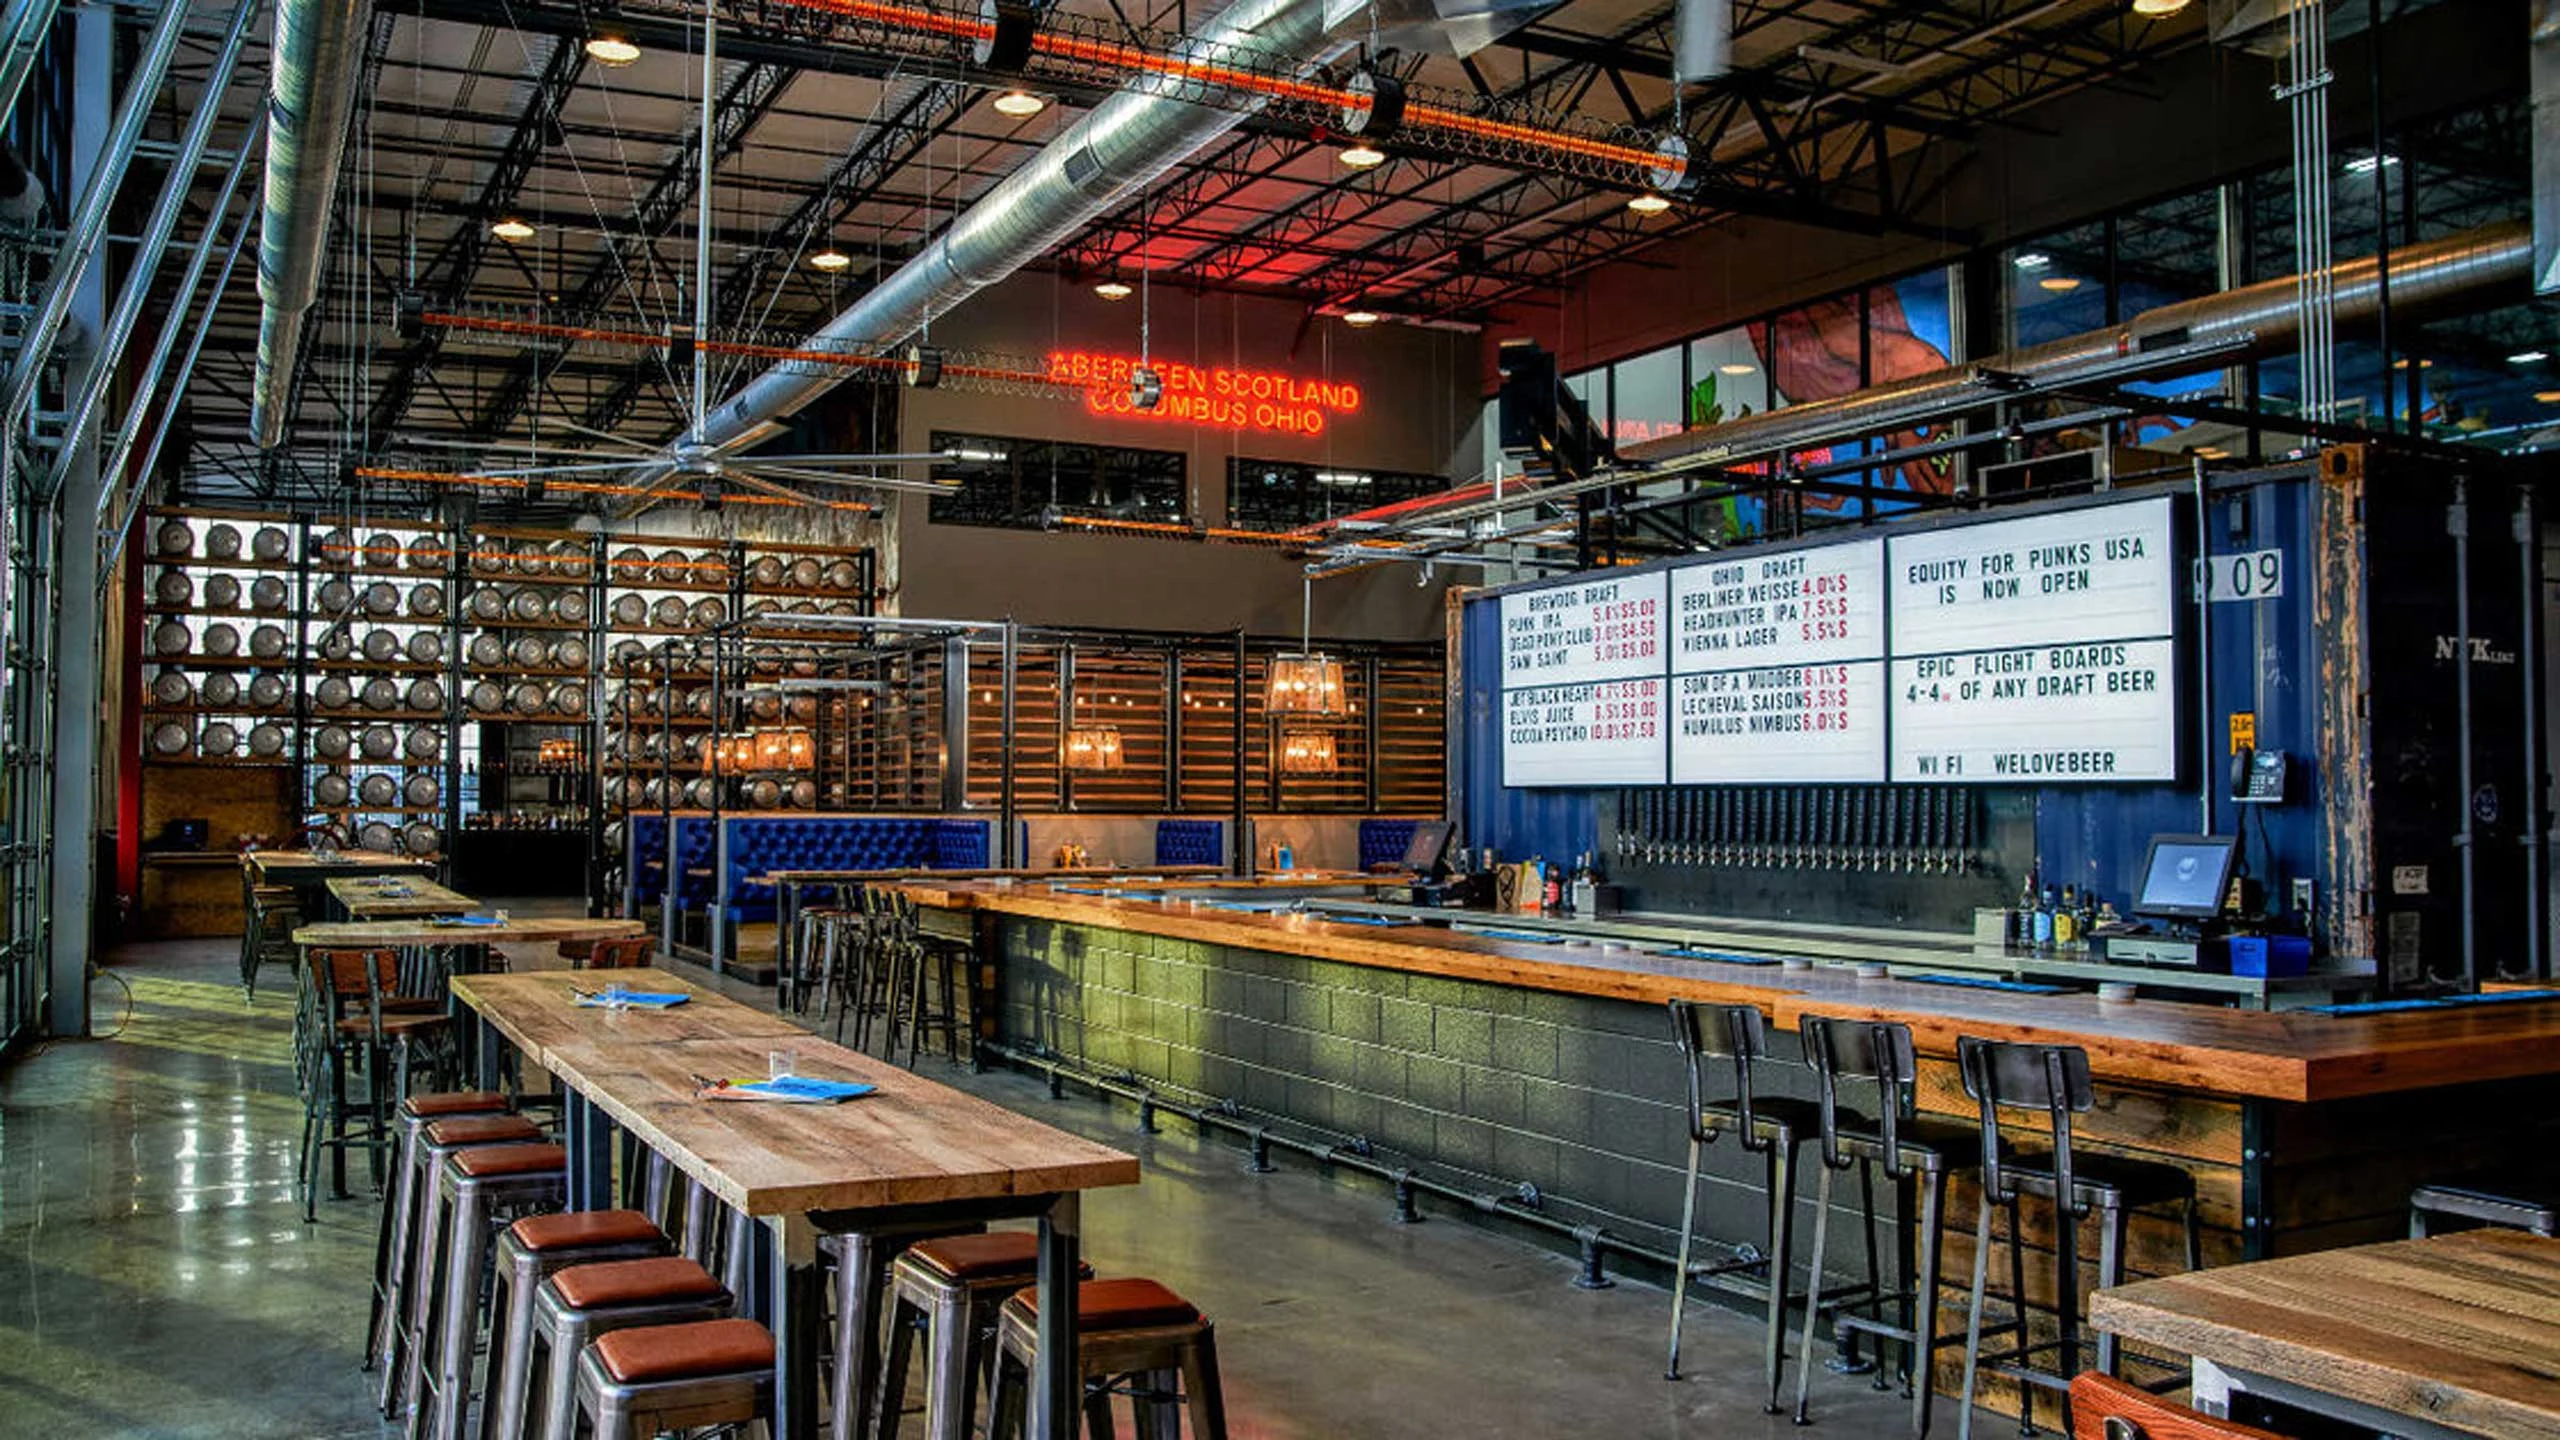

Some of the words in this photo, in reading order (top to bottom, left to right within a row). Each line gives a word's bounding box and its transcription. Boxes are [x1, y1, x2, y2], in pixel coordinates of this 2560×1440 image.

[1049, 354, 1206, 391] ABEREEN
[1215, 369, 1359, 408] SCOTLAND
[1091, 389, 1248, 426] COUMBUS
[1255, 403, 1324, 433] OHIO
[1712, 567, 1744, 586] OHIO
[1762, 558, 1806, 579] DRAFT
[1909, 559, 1967, 584] EQUITY
[1981, 553, 2014, 575] FOR
[2030, 543, 2090, 569] PUNKS
[2105, 538, 2145, 560] USA
[1585, 585, 1619, 604] DRAFT
[1683, 588, 1744, 611] BERLINER
[1749, 580, 1798, 603] WEISSE
[1940, 585, 1956, 604] IS
[1983, 578, 2020, 600] NOW
[2042, 570, 2089, 593] OPEN
[1508, 617, 1535, 633] PUNK
[1543, 614, 1562, 628] IPA
[1684, 608, 1765, 631] HEADHUNTER
[1774, 604, 1797, 623] IPA
[1683, 633, 1728, 652] VIENNA
[1736, 628, 1778, 647] LAGER
[1917, 659, 1955, 678] EPIC
[1975, 652, 2035, 675] FLIGHT
[2051, 646, 2126, 670] BOARDS
[1684, 676, 1708, 694] SON
[1712, 676, 1726, 691] OF
[1732, 676, 1740, 690] A
[1749, 669, 1801, 689] MUDDER
[1960, 681, 1980, 700] OF
[1993, 678, 2027, 699] ANY
[2037, 674, 2095, 697] DRAFT
[2107, 670, 2155, 693] BEER
[1511, 710, 1538, 725] ELVIS
[1546, 706, 1573, 723] JUICE
[1700, 696, 1747, 714] CHEVAL
[1752, 692, 1803, 711] SAISON
[1750, 714, 1800, 733] NIMBUS
[1994, 752, 2115, 774] WELOVEBEER
